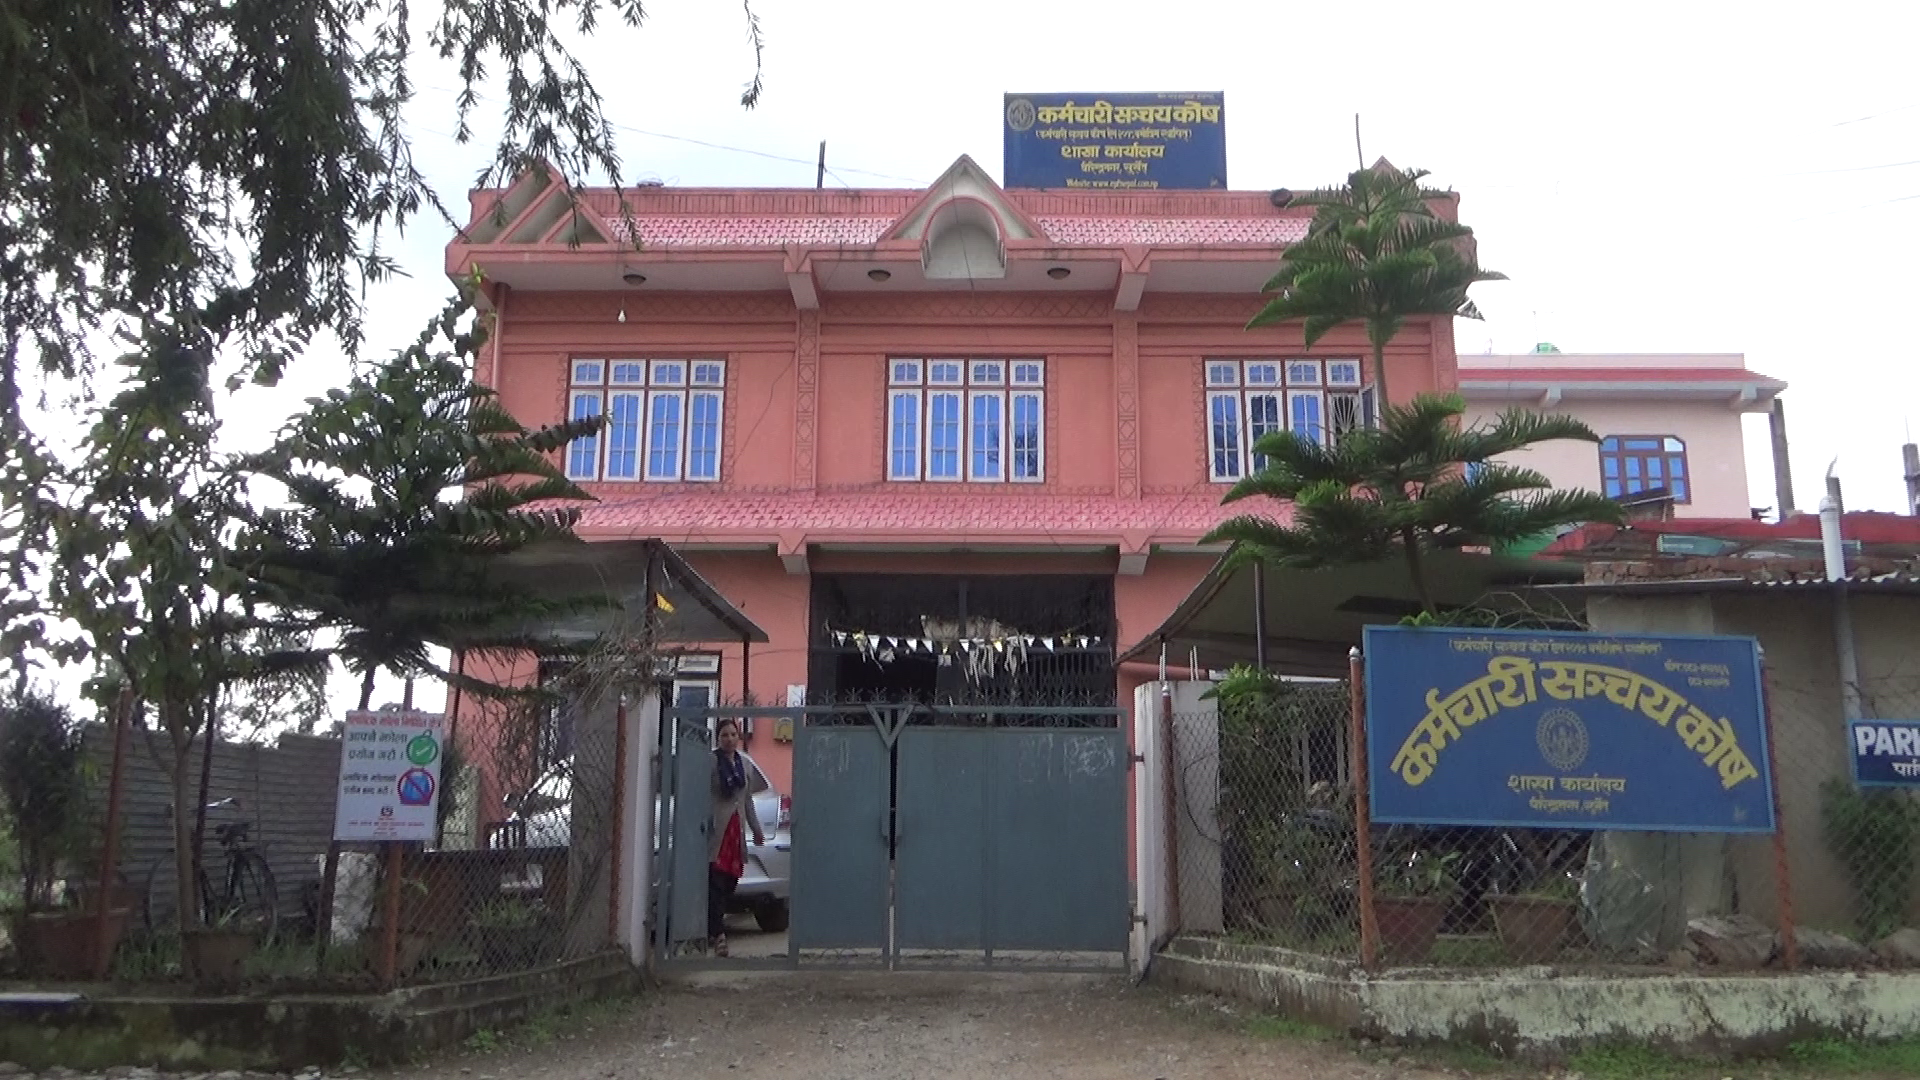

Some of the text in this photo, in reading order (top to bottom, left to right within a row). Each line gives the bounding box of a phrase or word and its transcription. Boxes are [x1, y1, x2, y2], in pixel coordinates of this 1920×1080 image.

[1038, 100, 1220, 124] कर्मचारी सञ्चय कोष
[1061, 142, 1165, 159] शाखा कार्यालय
[1390, 656, 1759, 792] कर्मचारी सञ्चय कोष
[1508, 772, 1626, 795] शाखा कार्यालय
